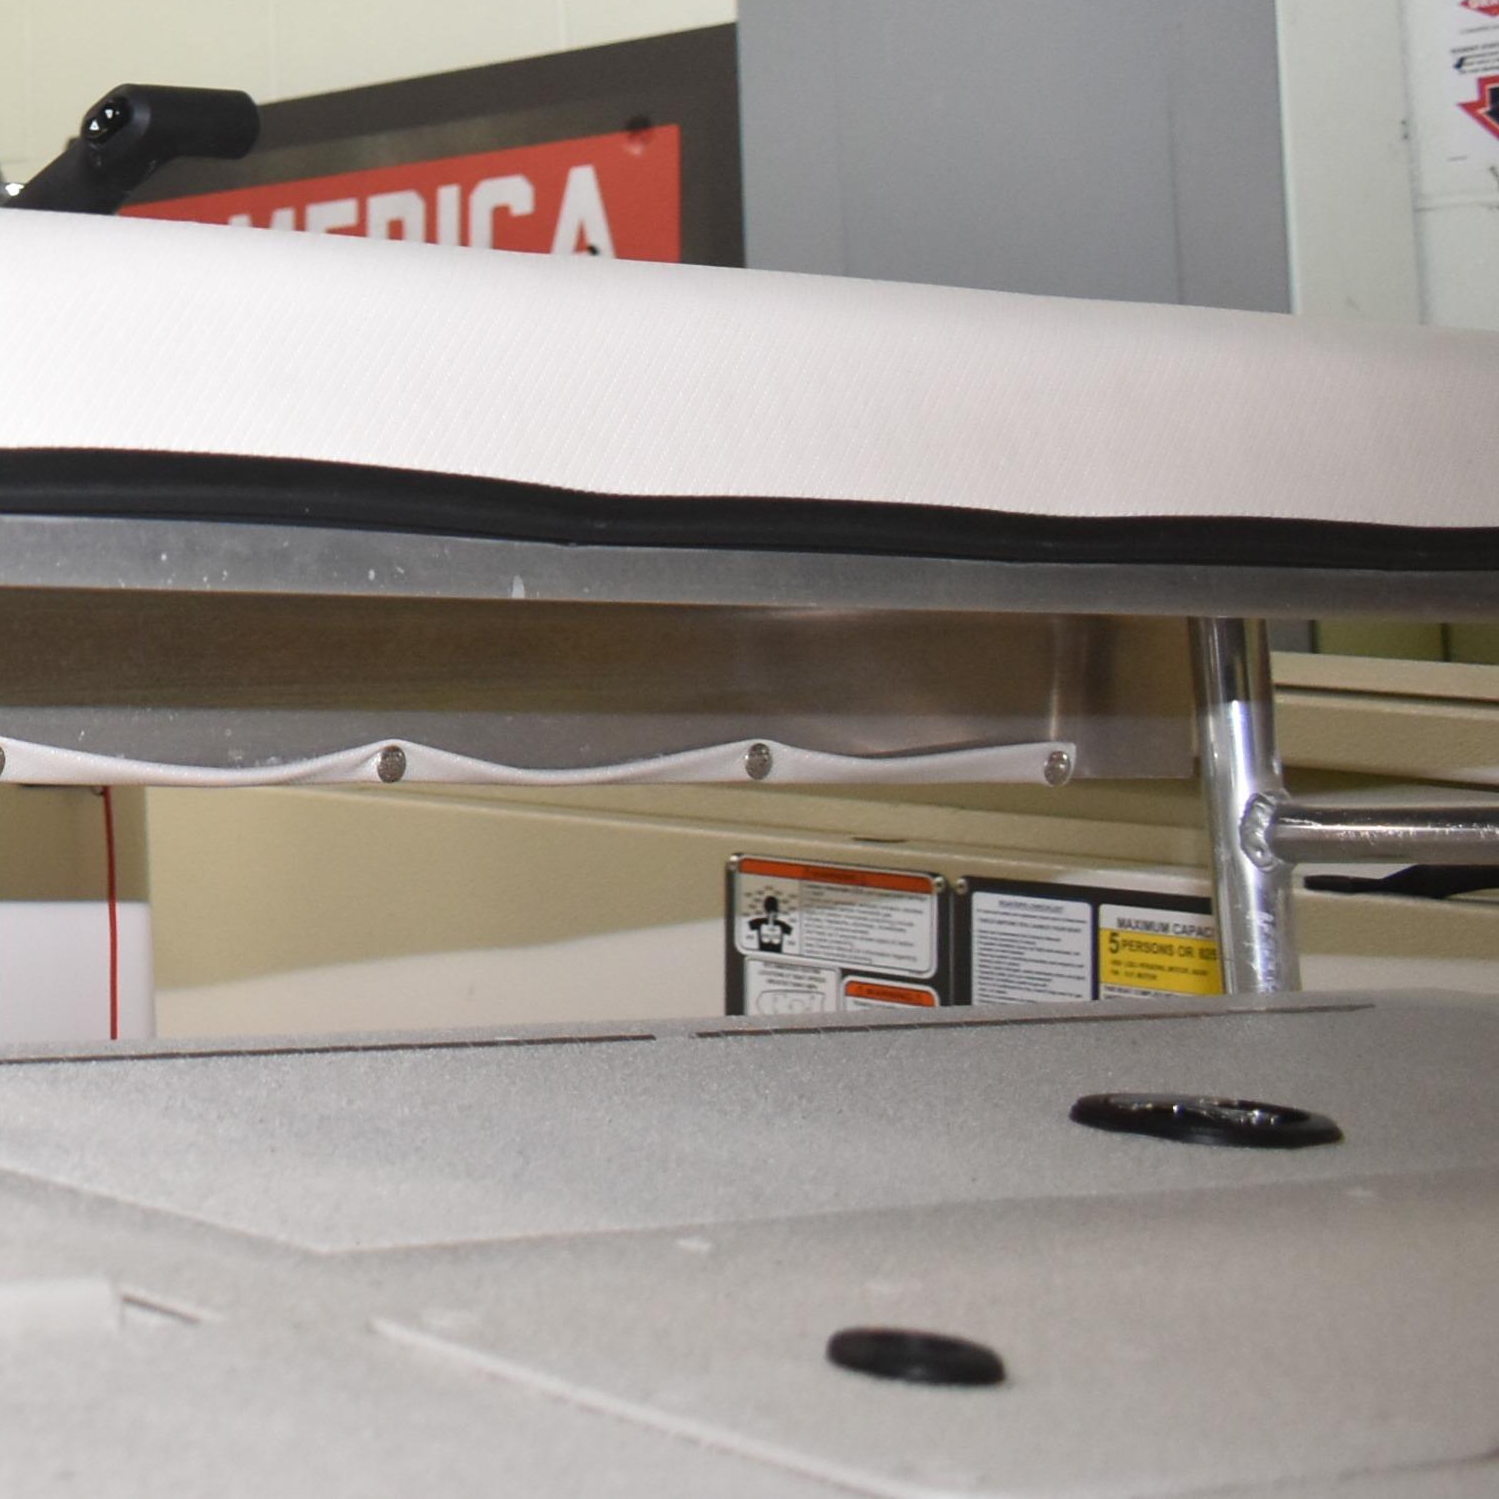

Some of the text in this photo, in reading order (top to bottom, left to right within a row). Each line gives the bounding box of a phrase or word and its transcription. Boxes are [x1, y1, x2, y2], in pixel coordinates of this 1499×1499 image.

[1116, 917, 1170, 934] MAXIMUM
[1108, 931, 1120, 955] 5
[1121, 938, 1175, 957] PERSONS
[1178, 946, 1195, 959] OR
